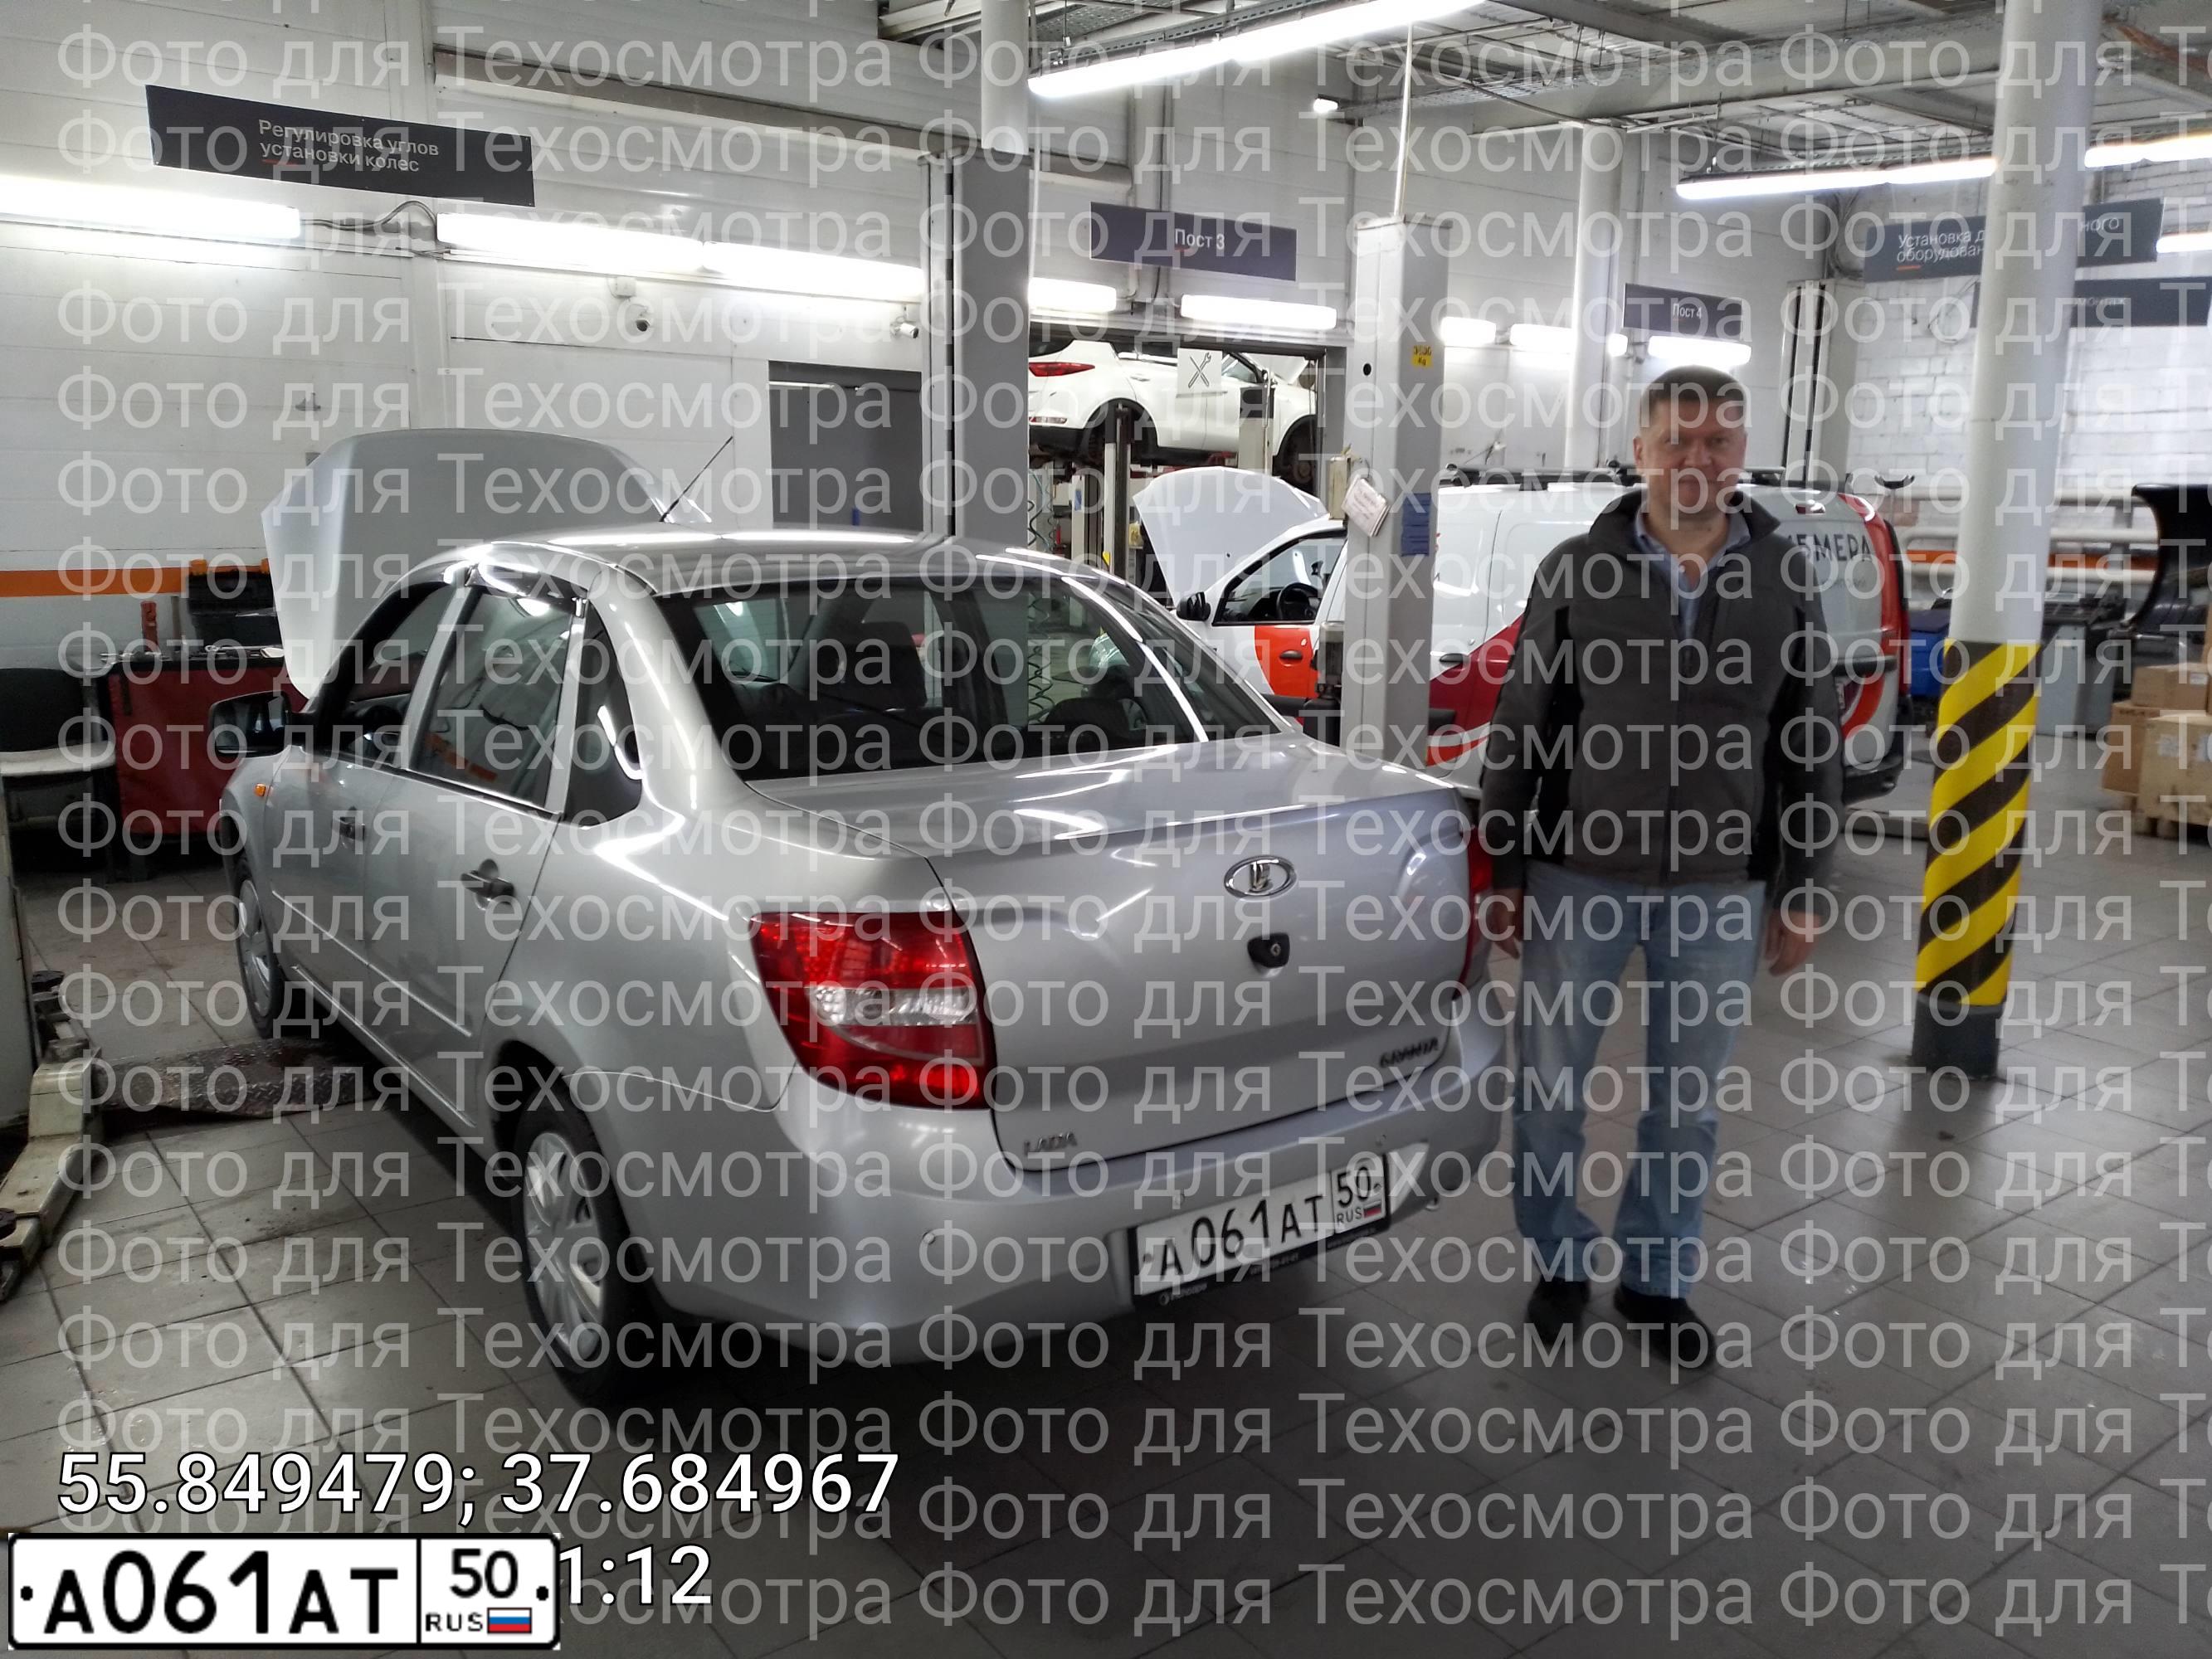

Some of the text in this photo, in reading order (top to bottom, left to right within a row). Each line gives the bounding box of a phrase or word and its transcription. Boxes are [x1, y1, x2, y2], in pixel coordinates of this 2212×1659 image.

[259, 119, 439, 156] Регулировка углов
[260, 142, 419, 173] установки колес
[1175, 227, 1225, 251] Пост 3
[1898, 231, 1971, 249] Установка
[1897, 245, 1985, 263] оборудован
[1672, 303, 1703, 319] Пост 4
[1337, 1166, 1372, 1208] 50
[1336, 1207, 1362, 1225] RUS
